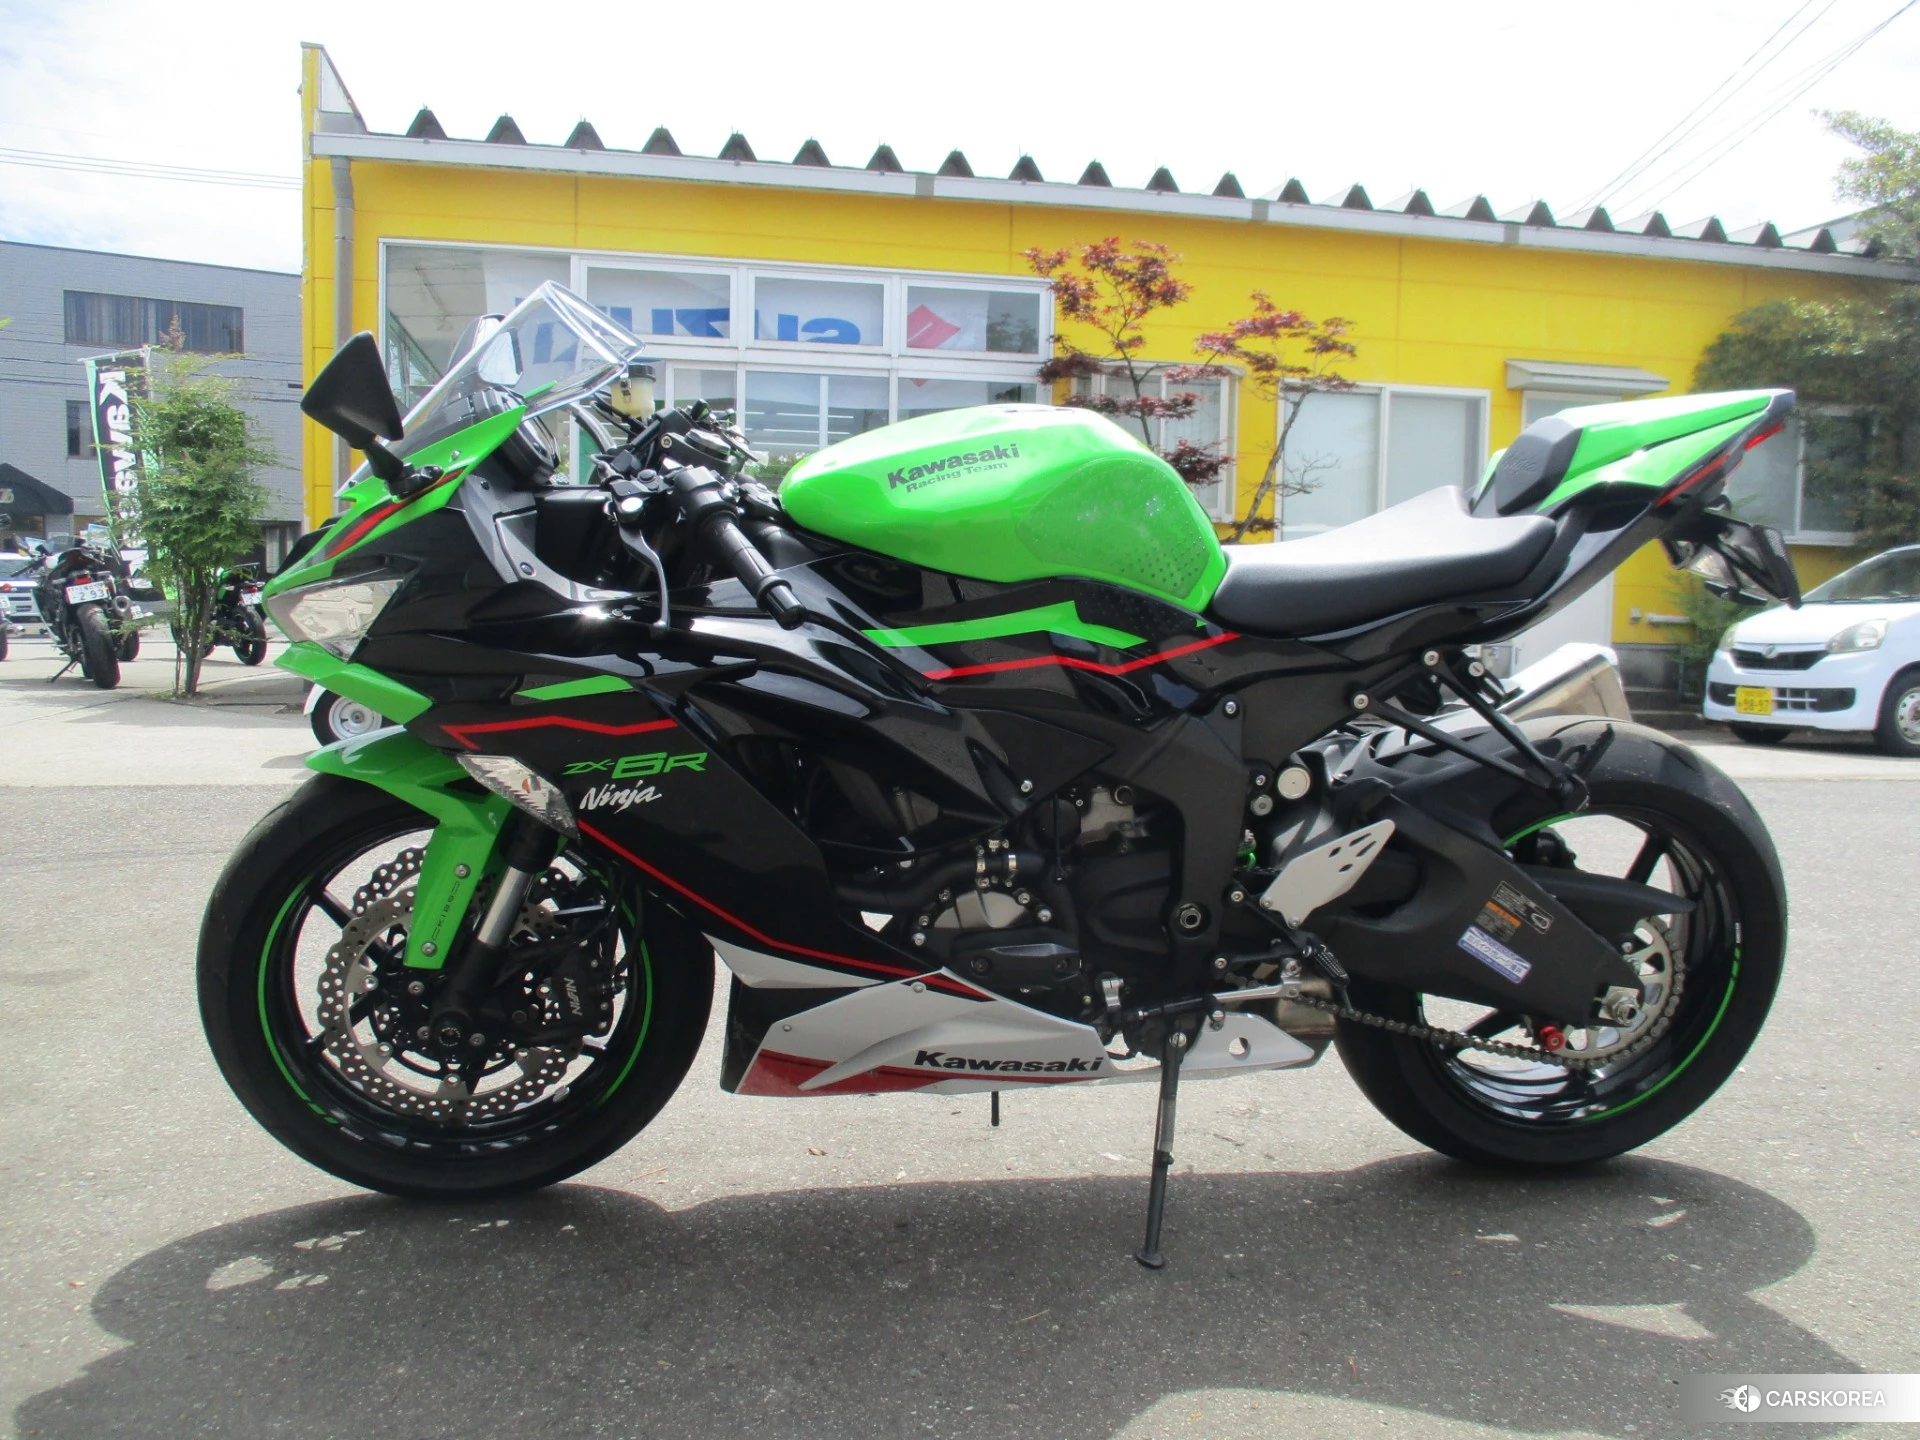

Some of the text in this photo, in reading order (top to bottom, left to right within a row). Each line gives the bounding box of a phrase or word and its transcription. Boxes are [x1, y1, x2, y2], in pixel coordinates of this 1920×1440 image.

[887, 443, 1020, 489] Kawasaki
[906, 462, 1009, 493] Racing Team
[561, 752, 708, 779] ZX-6R
[579, 780, 662, 814] Ninja
[563, 977, 583, 1016] NISSIN
[914, 1050, 1104, 1072] Kawasaki
